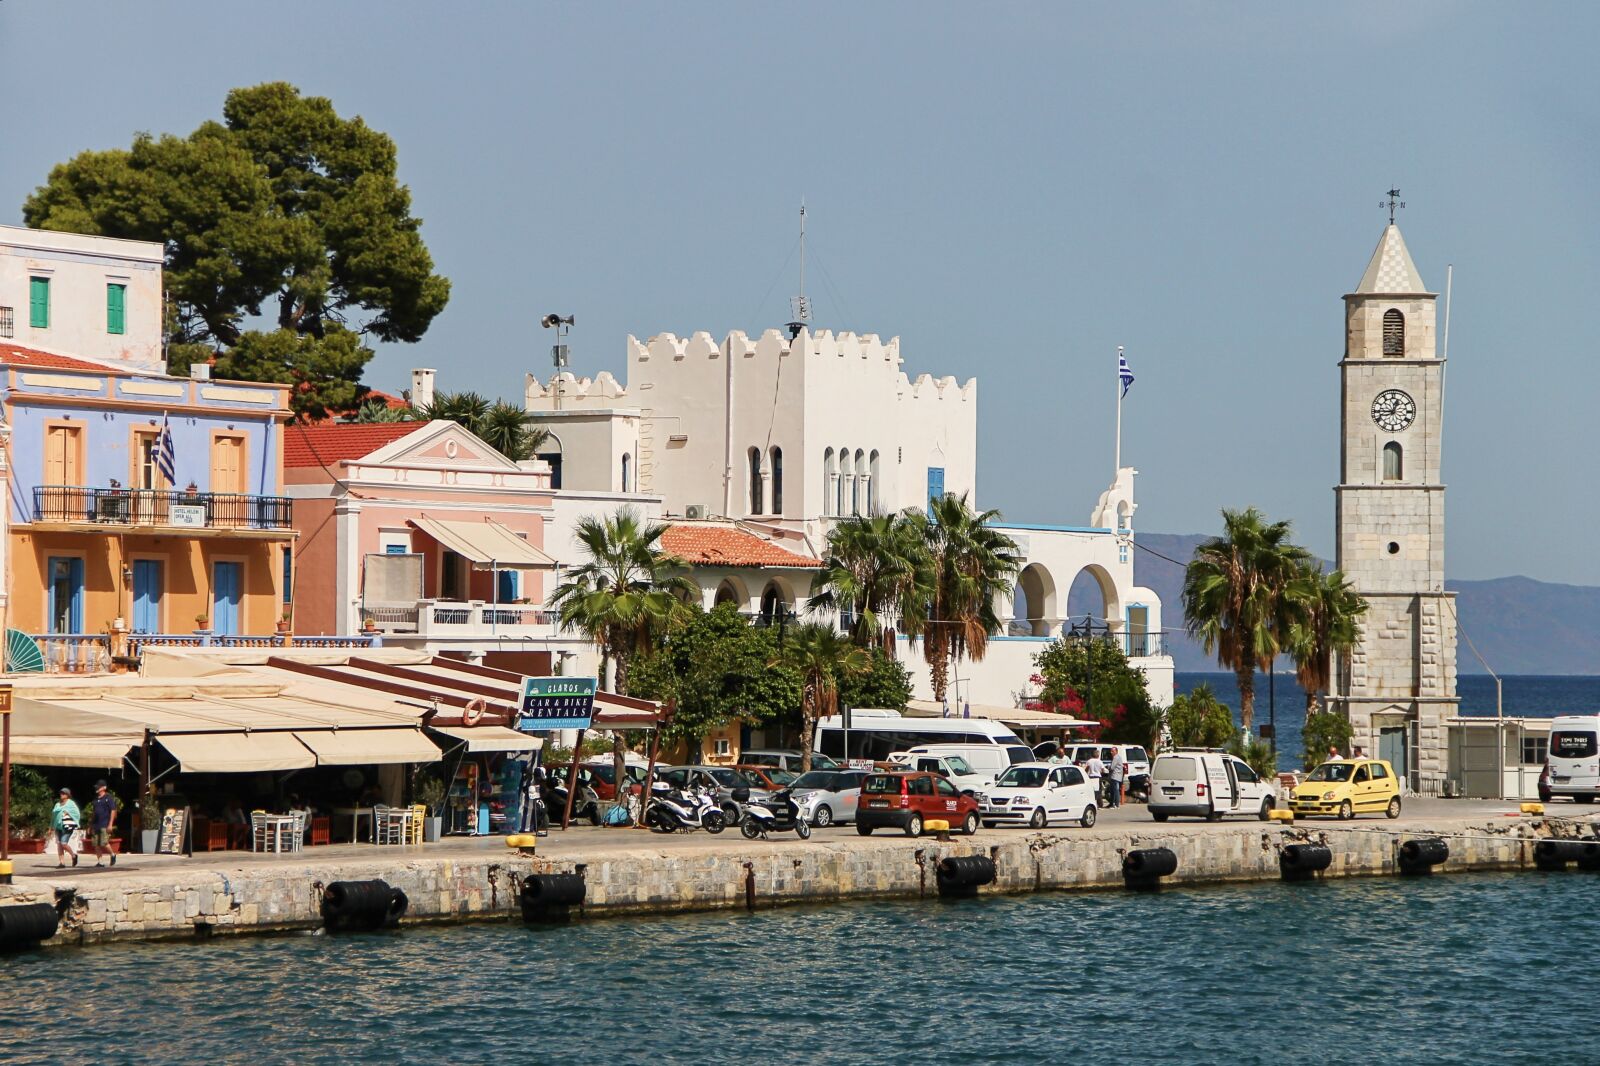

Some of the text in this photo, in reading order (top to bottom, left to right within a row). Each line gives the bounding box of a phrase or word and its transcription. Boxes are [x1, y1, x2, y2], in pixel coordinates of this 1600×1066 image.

[547, 683, 579, 694] GLAROS
[530, 698, 588, 707] CAR & BIKE
[528, 707, 587, 718] RENTALS
